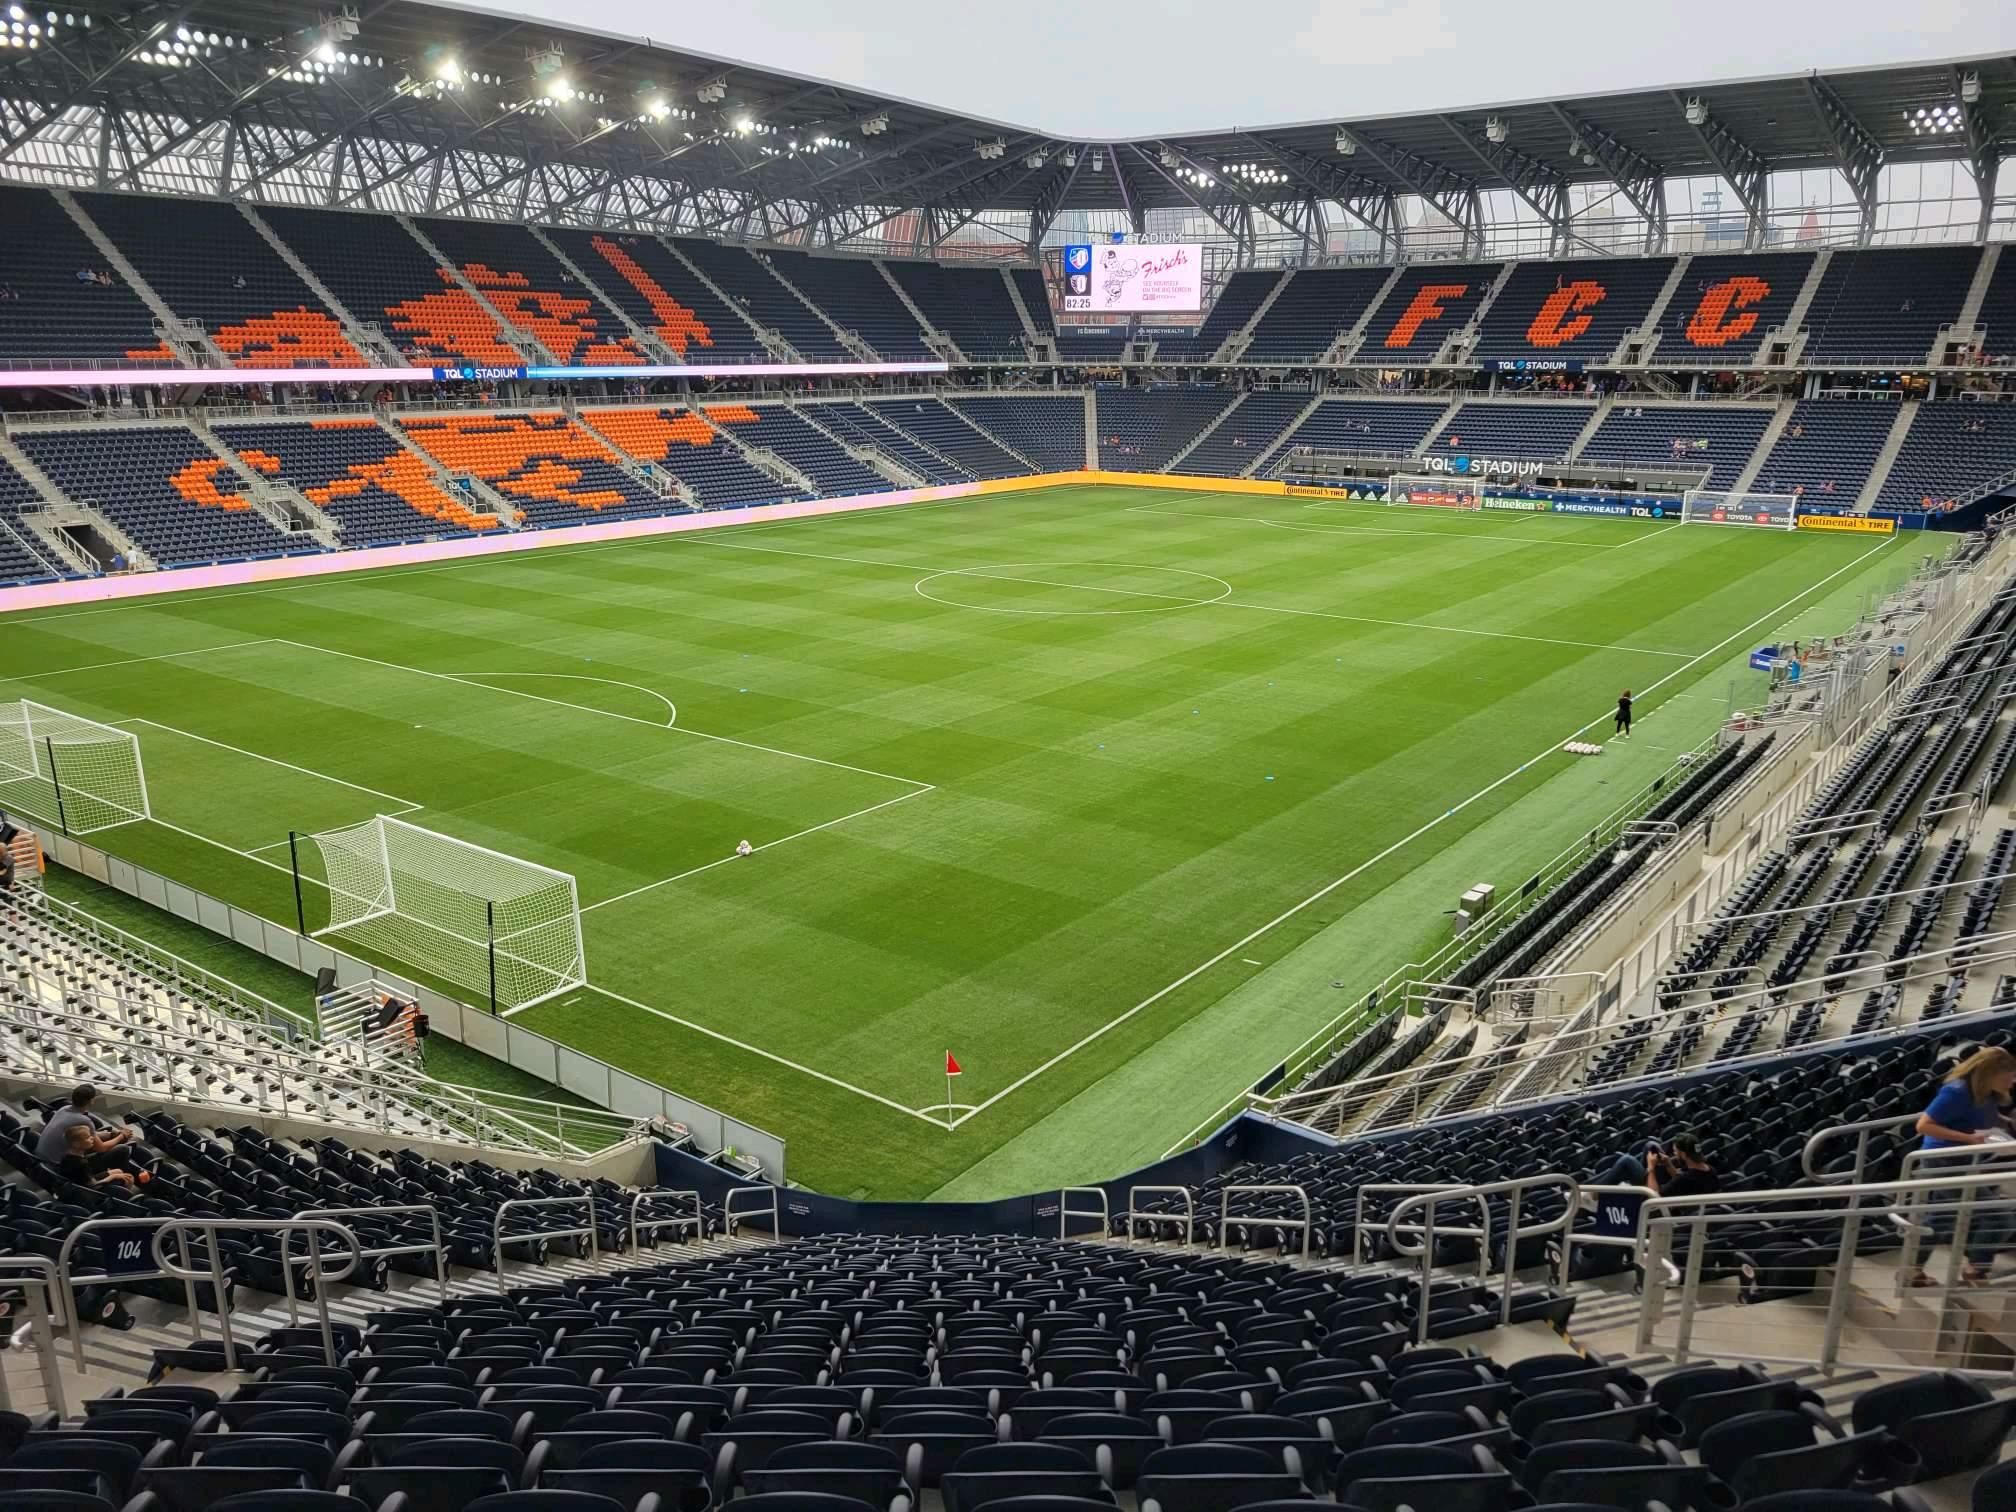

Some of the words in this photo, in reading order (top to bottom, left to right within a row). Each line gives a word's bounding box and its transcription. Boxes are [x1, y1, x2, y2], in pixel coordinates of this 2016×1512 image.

[1141, 249, 1188, 279] Frisch's
[1066, 299, 1091, 308] 82:25
[1498, 361, 1516, 369] TQL
[1525, 361, 1567, 369] STADIUM
[444, 368, 464, 378] TQL
[474, 368, 518, 378] STADIUM
[1423, 457, 1452, 471] TQL
[1471, 459, 1543, 475] STADIUM
[1286, 485, 1323, 495] Continental
[1485, 499, 1535, 510] Heineken
[1631, 507, 1652, 517] TQL
[1802, 516, 1857, 527] Continental
[1868, 521, 1890, 529] TIRE
[1605, 1206, 1630, 1225] 104
[117, 1240, 142, 1260] 104
